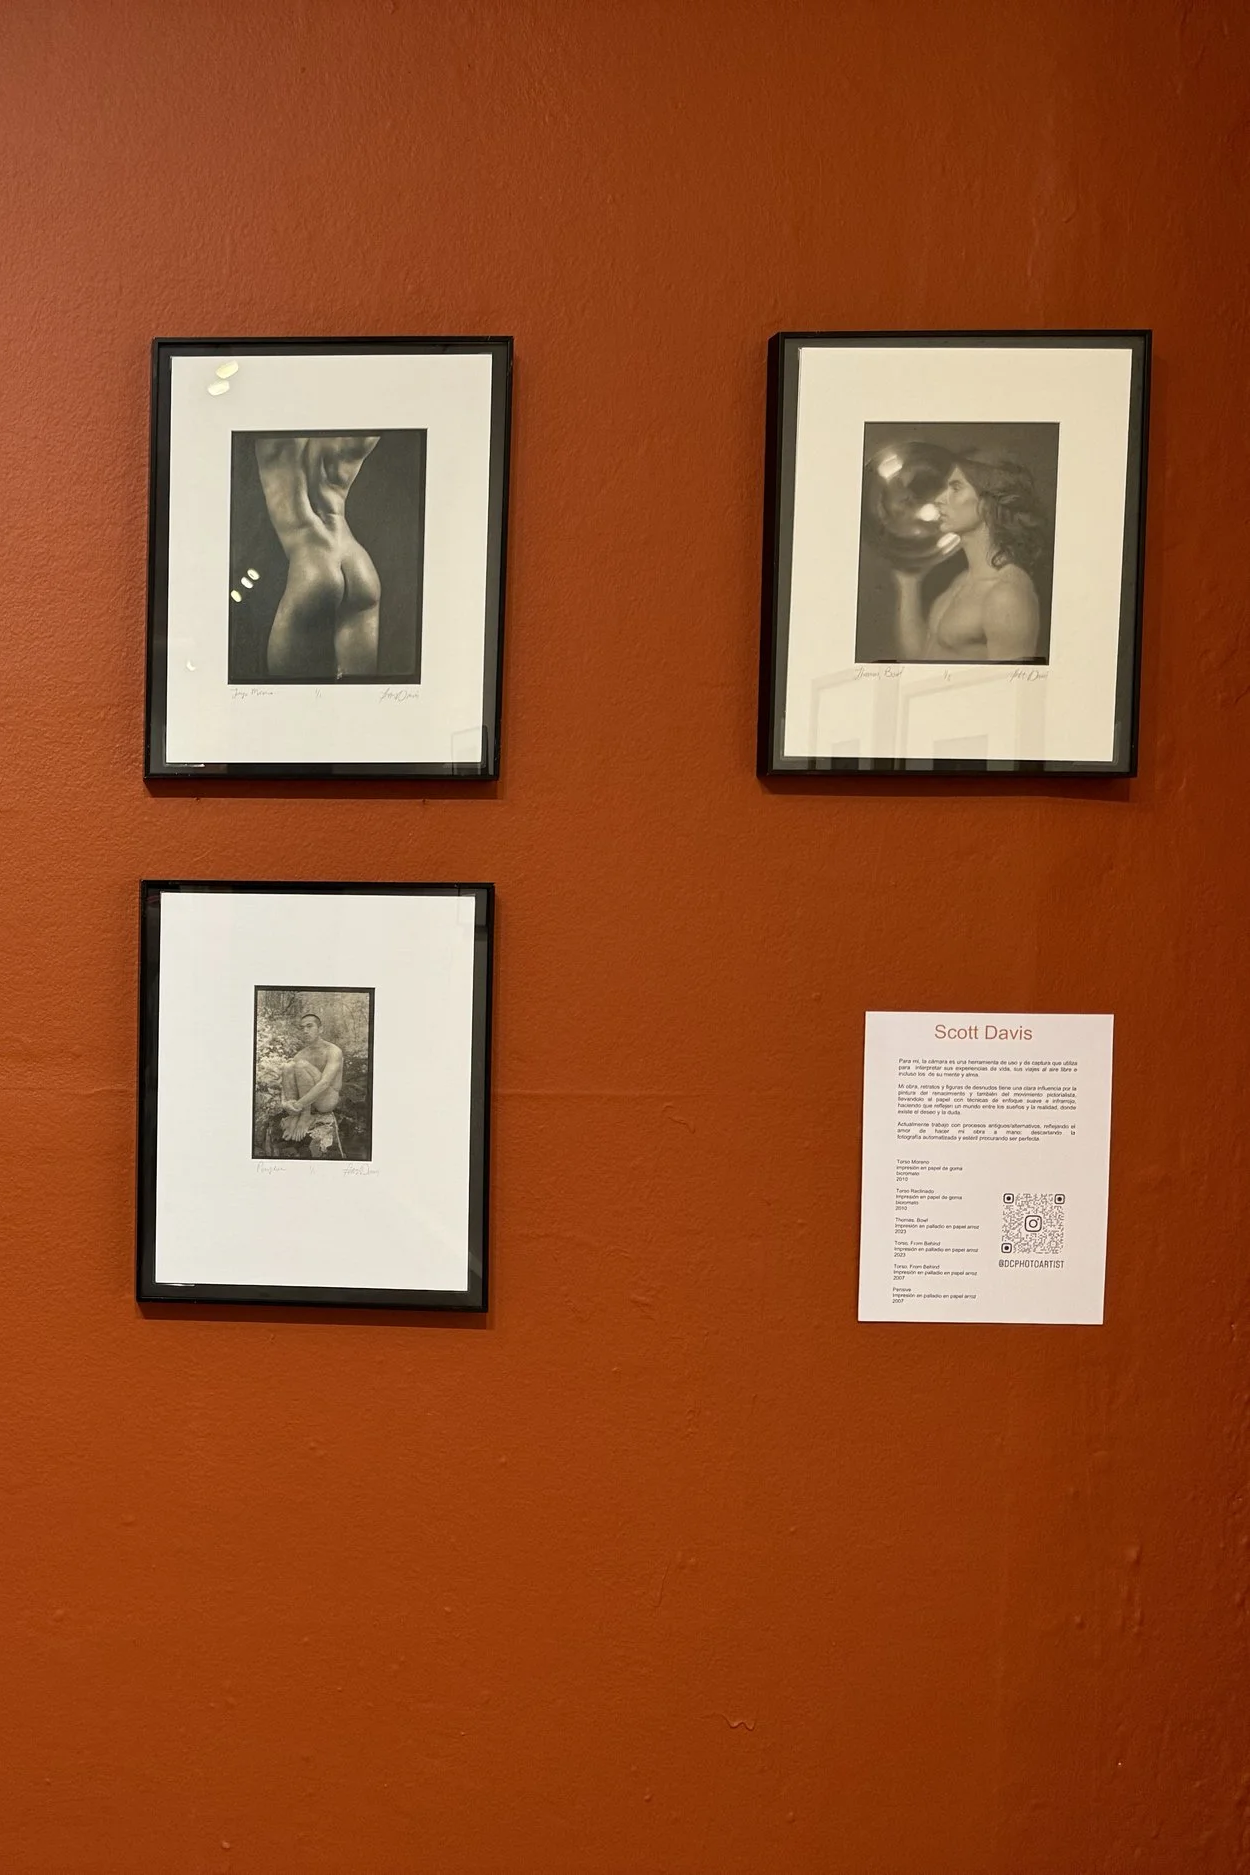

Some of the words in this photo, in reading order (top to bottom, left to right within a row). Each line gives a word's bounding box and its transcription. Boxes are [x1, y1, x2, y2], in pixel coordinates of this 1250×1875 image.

[934, 1024, 978, 1039] Scott
[985, 1025, 1032, 1040] Davis
[998, 1260, 1064, 1268] @DCPHOTOARTIST
